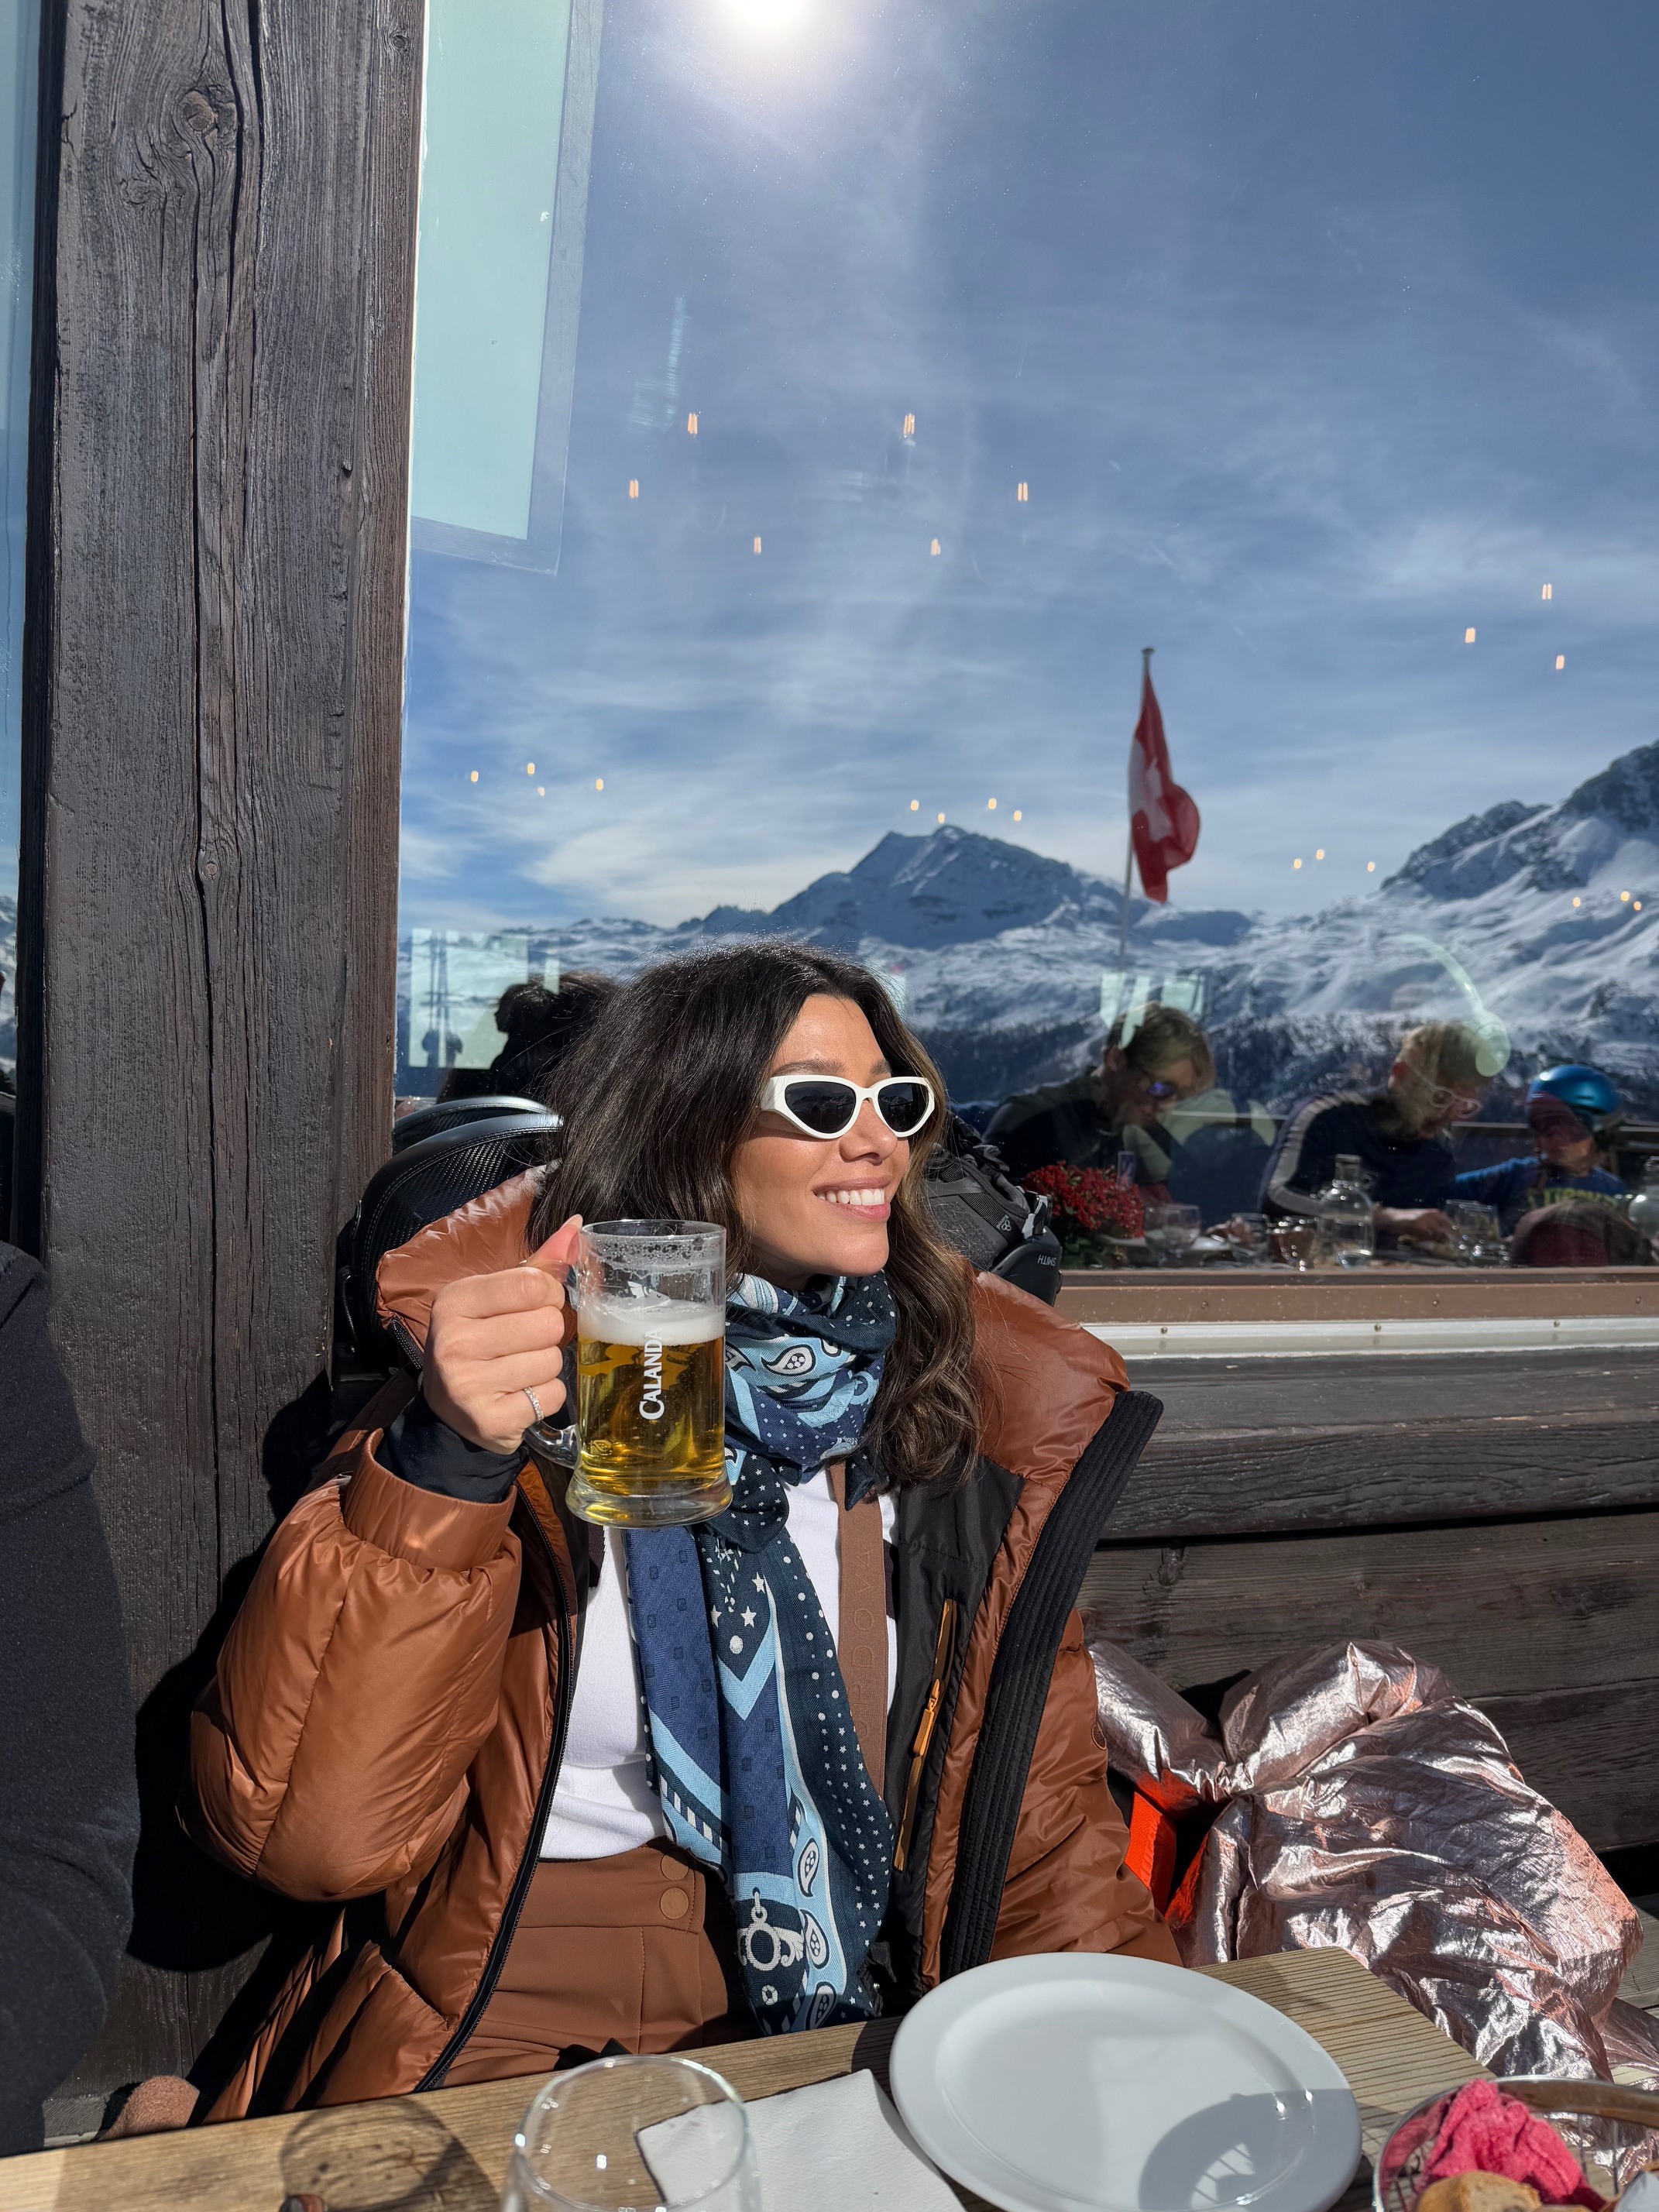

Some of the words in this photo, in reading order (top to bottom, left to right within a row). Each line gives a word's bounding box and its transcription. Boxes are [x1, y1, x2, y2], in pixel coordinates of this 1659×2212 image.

[1037, 1254, 1056, 1266] SMITH
[639, 1328, 665, 1420] CALANDA
[848, 1551, 874, 1740] ORDOVA
